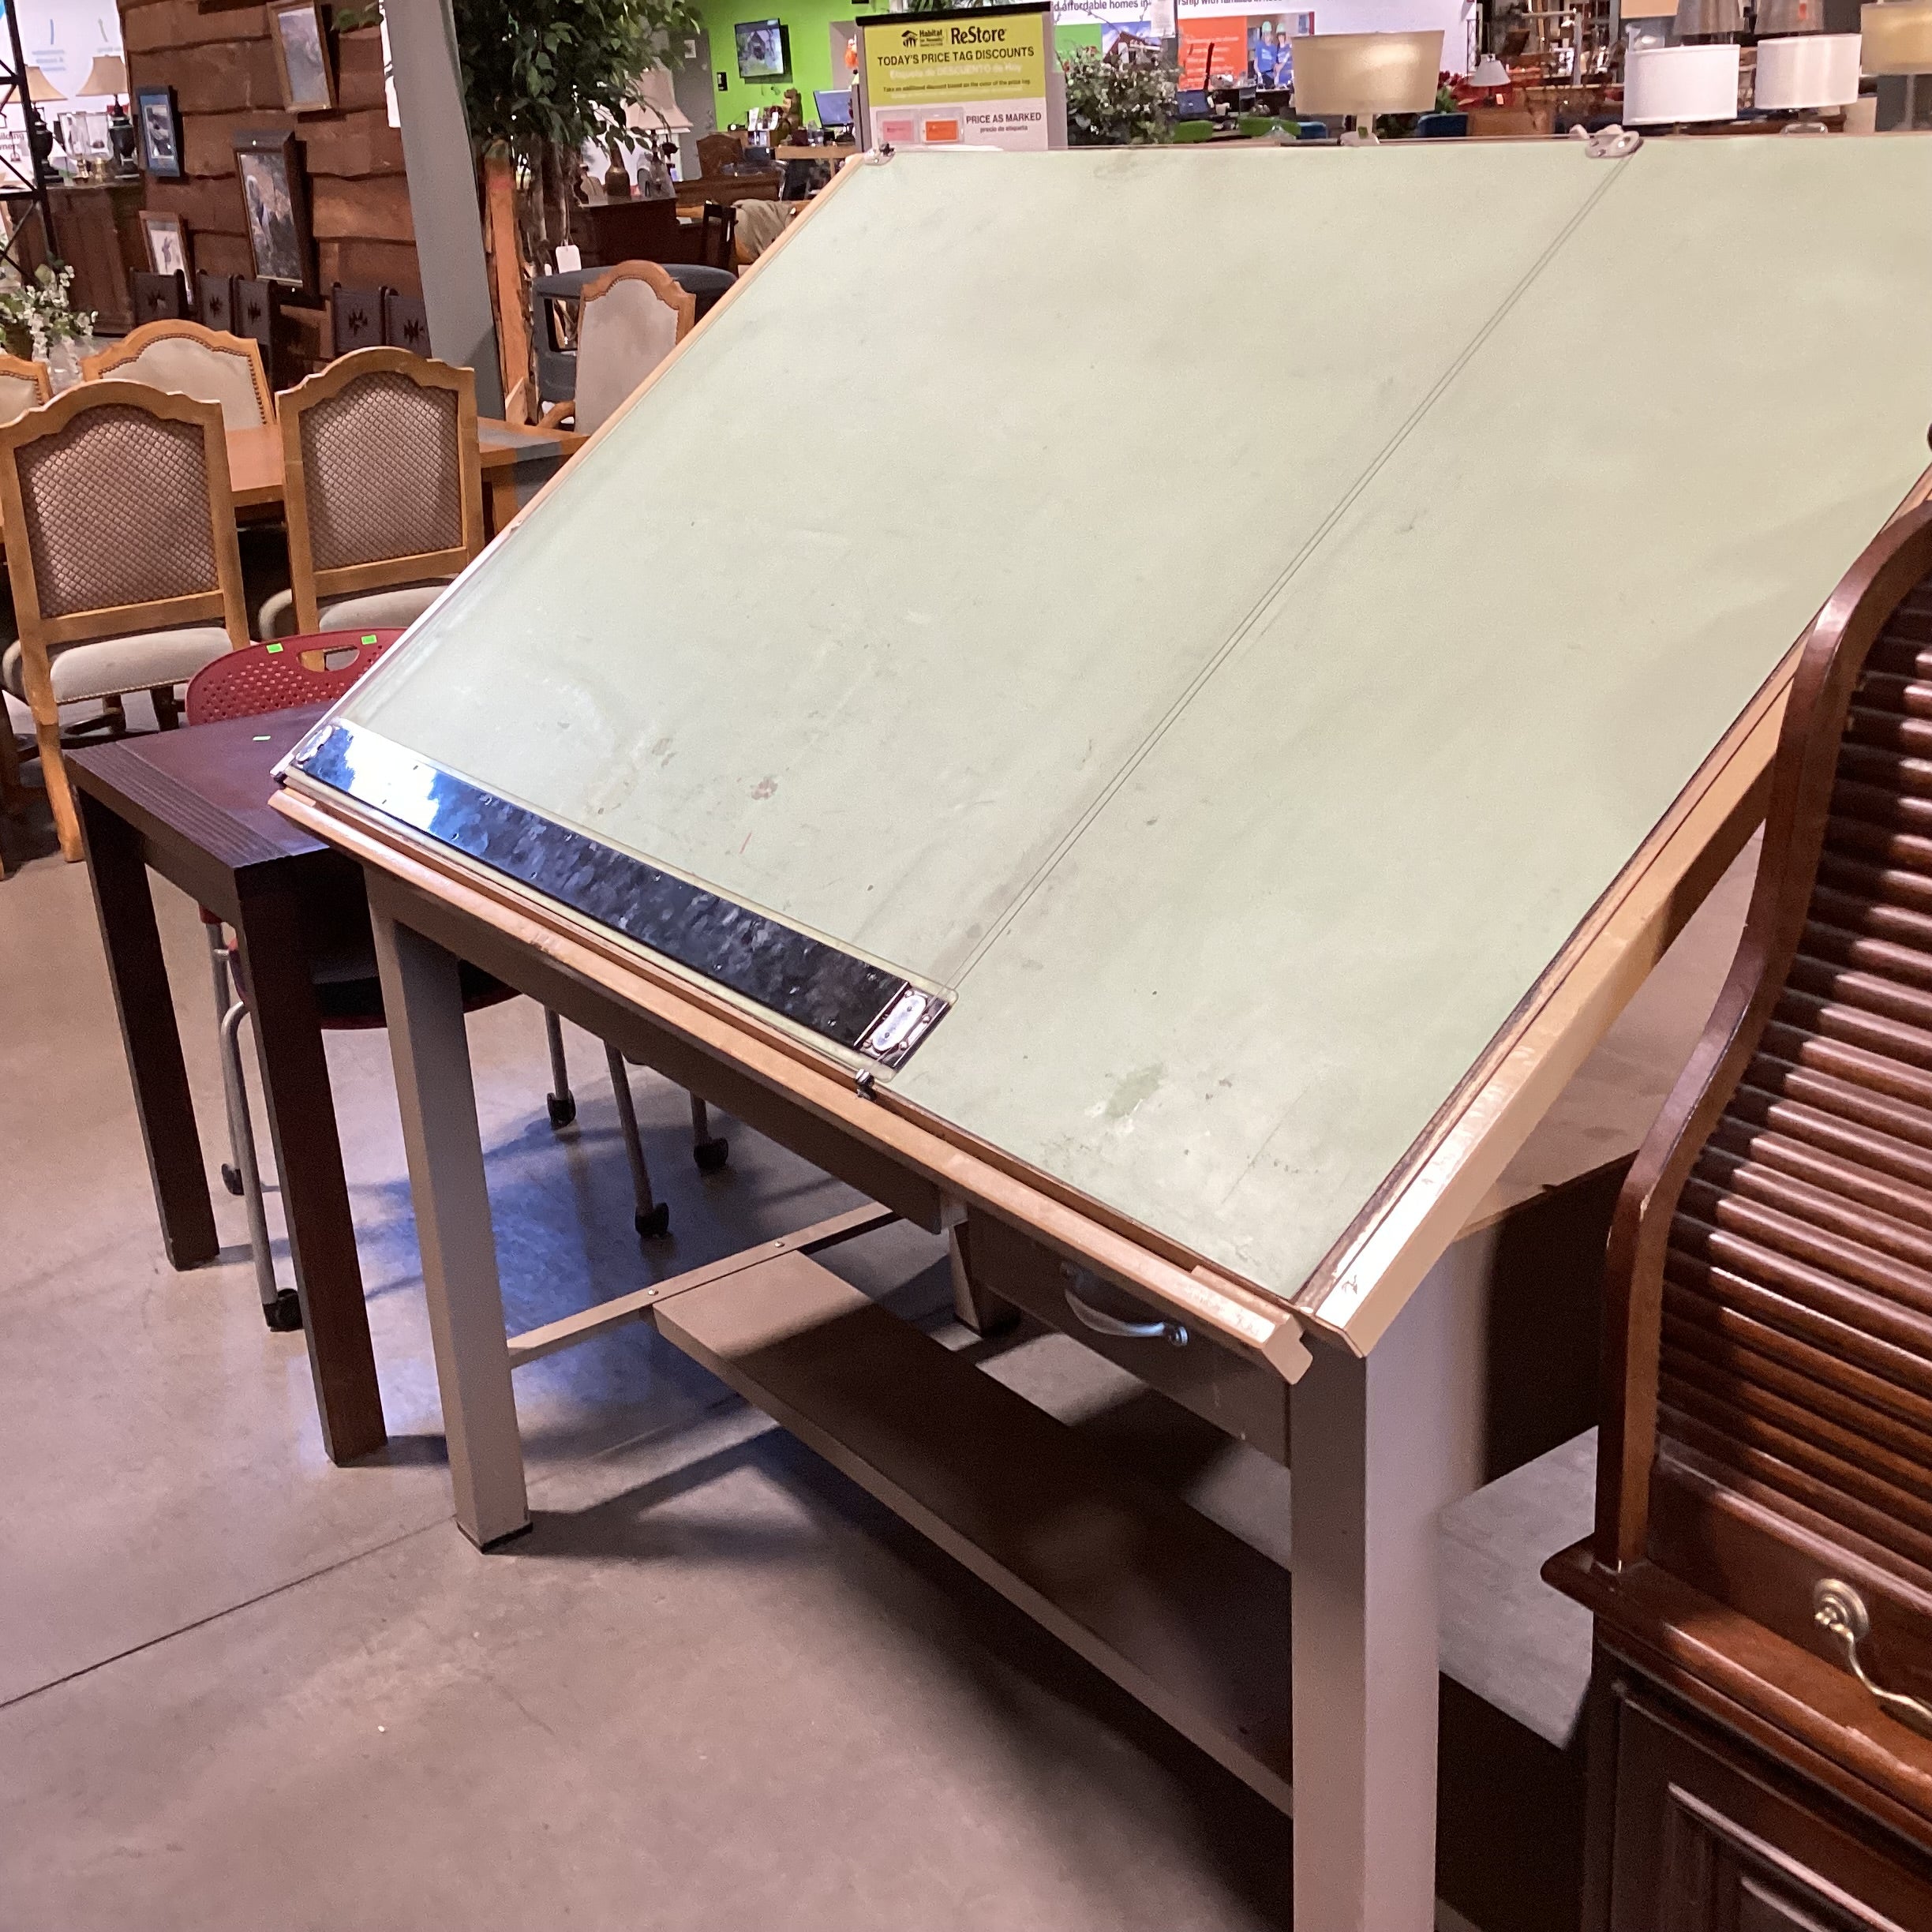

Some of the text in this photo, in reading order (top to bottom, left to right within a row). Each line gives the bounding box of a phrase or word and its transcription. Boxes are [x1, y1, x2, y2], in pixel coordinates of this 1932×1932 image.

[1109, 1, 1138, 11] homes
[919, 28, 942, 37] Habitat
[951, 26, 1005, 44] ReStore
[877, 47, 1034, 66] TODAY'S PRICE TAG DISCOUNTS
[966, 112, 1042, 125] PRICE AS MARKED
